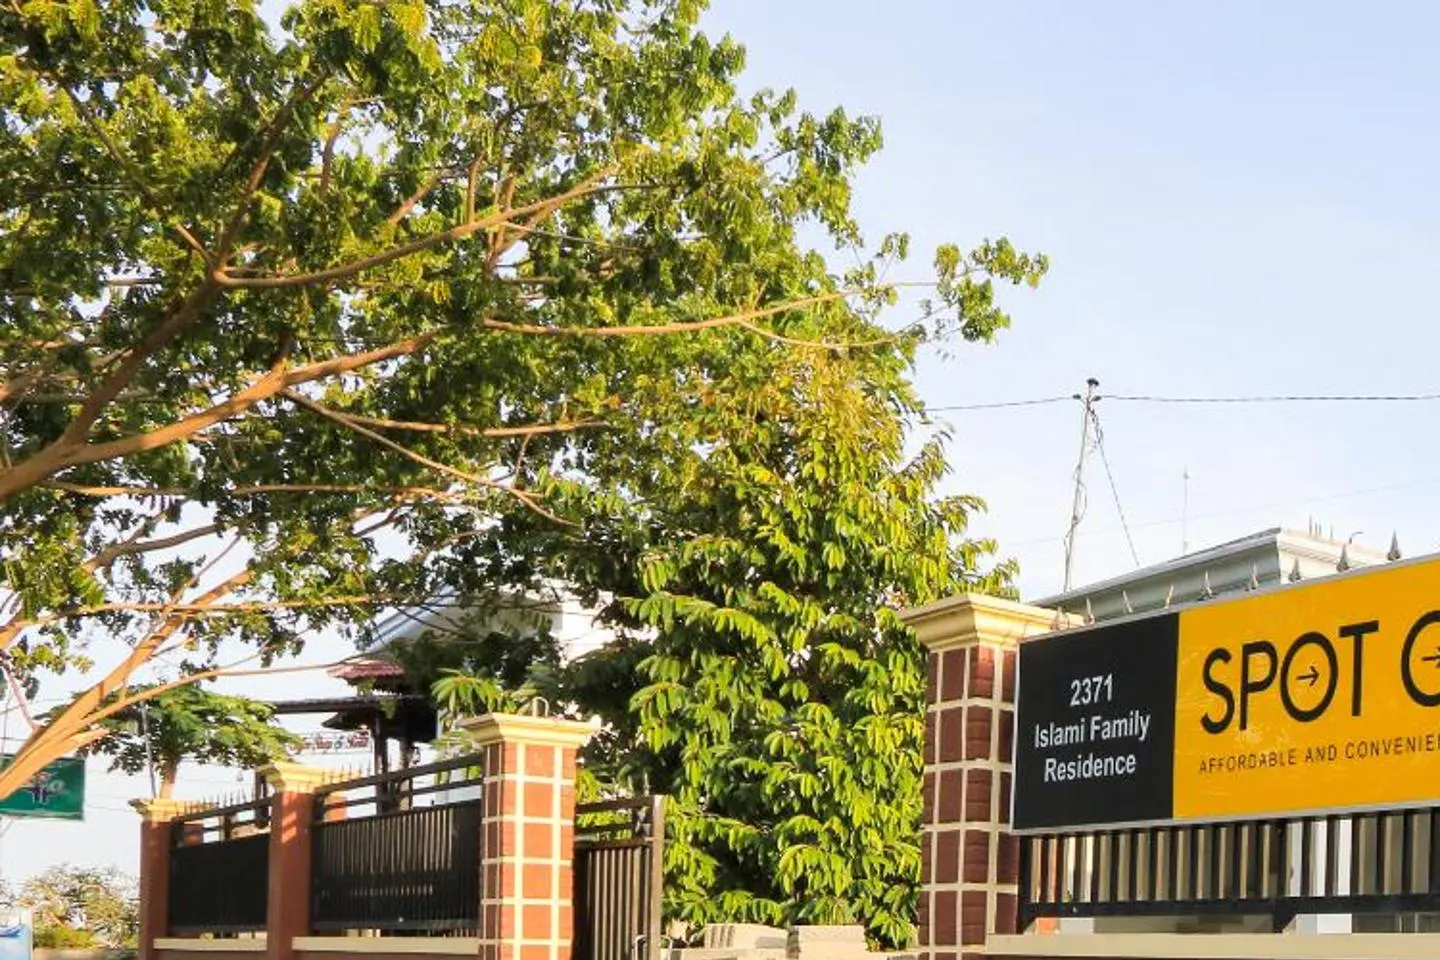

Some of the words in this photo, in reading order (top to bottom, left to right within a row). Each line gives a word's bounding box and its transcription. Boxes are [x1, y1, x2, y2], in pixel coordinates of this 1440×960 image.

[1069, 673, 1114, 707] 2371
[1200, 619, 1380, 735] SPOT
[1034, 717, 1086, 748] Islami
[1090, 709, 1152, 741] Family
[1044, 752, 1137, 782] Residence
[1199, 748, 1297, 773] AFFORDABLE
[1304, 744, 1338, 763] AND
